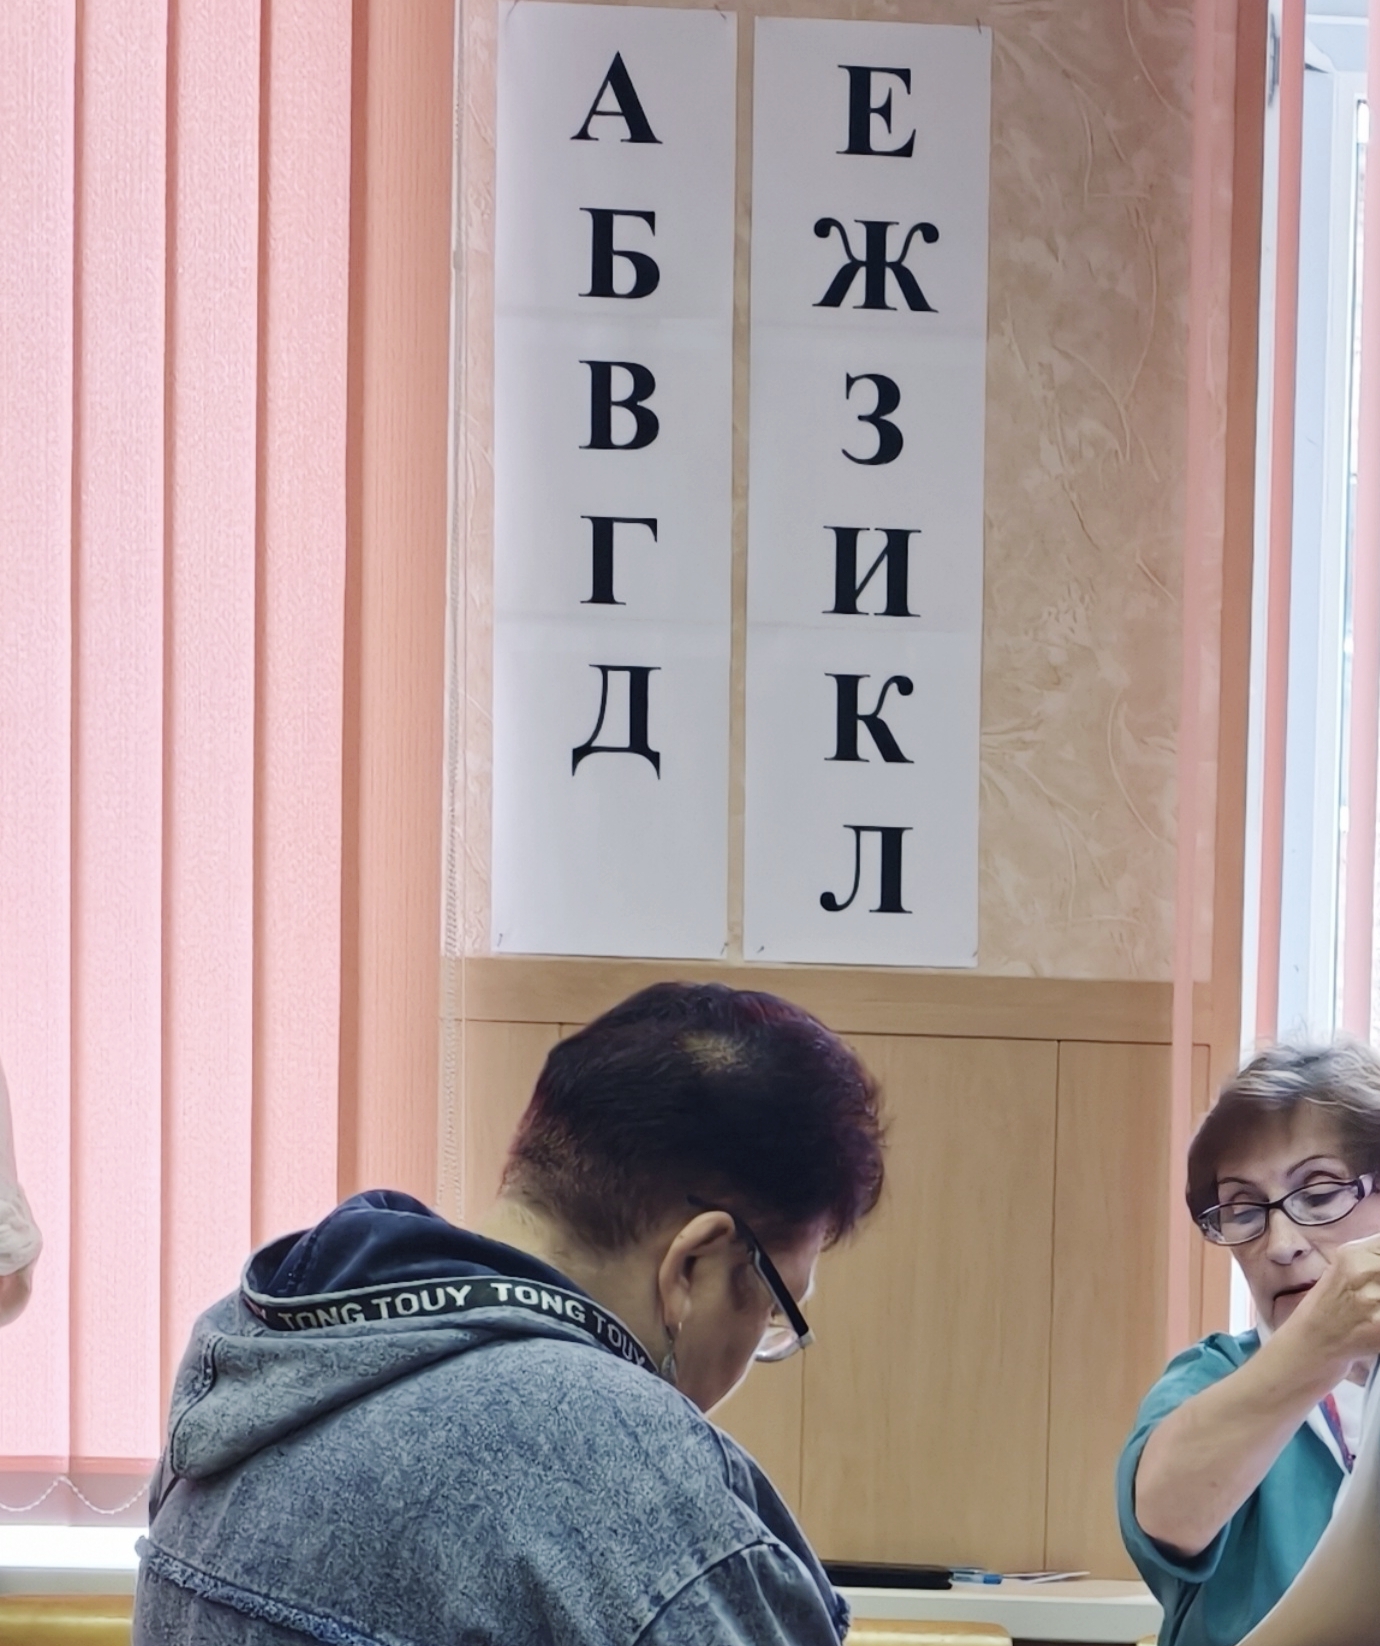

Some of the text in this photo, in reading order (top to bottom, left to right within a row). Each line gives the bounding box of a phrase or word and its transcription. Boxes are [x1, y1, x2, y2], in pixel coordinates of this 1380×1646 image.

[570, 50, 663, 145] А
[835, 64, 917, 159] Е
[578, 207, 661, 300] Б
[812, 216, 940, 314] Ж
[578, 360, 660, 451] В
[841, 372, 904, 466] З
[580, 515, 658, 606] Г
[822, 525, 922, 618] И
[571, 664, 662, 780] Д
[824, 672, 915, 764] К
[819, 824, 913, 914] Л
[278, 1282, 647, 1366] TONG TOUY TONG TOUY
